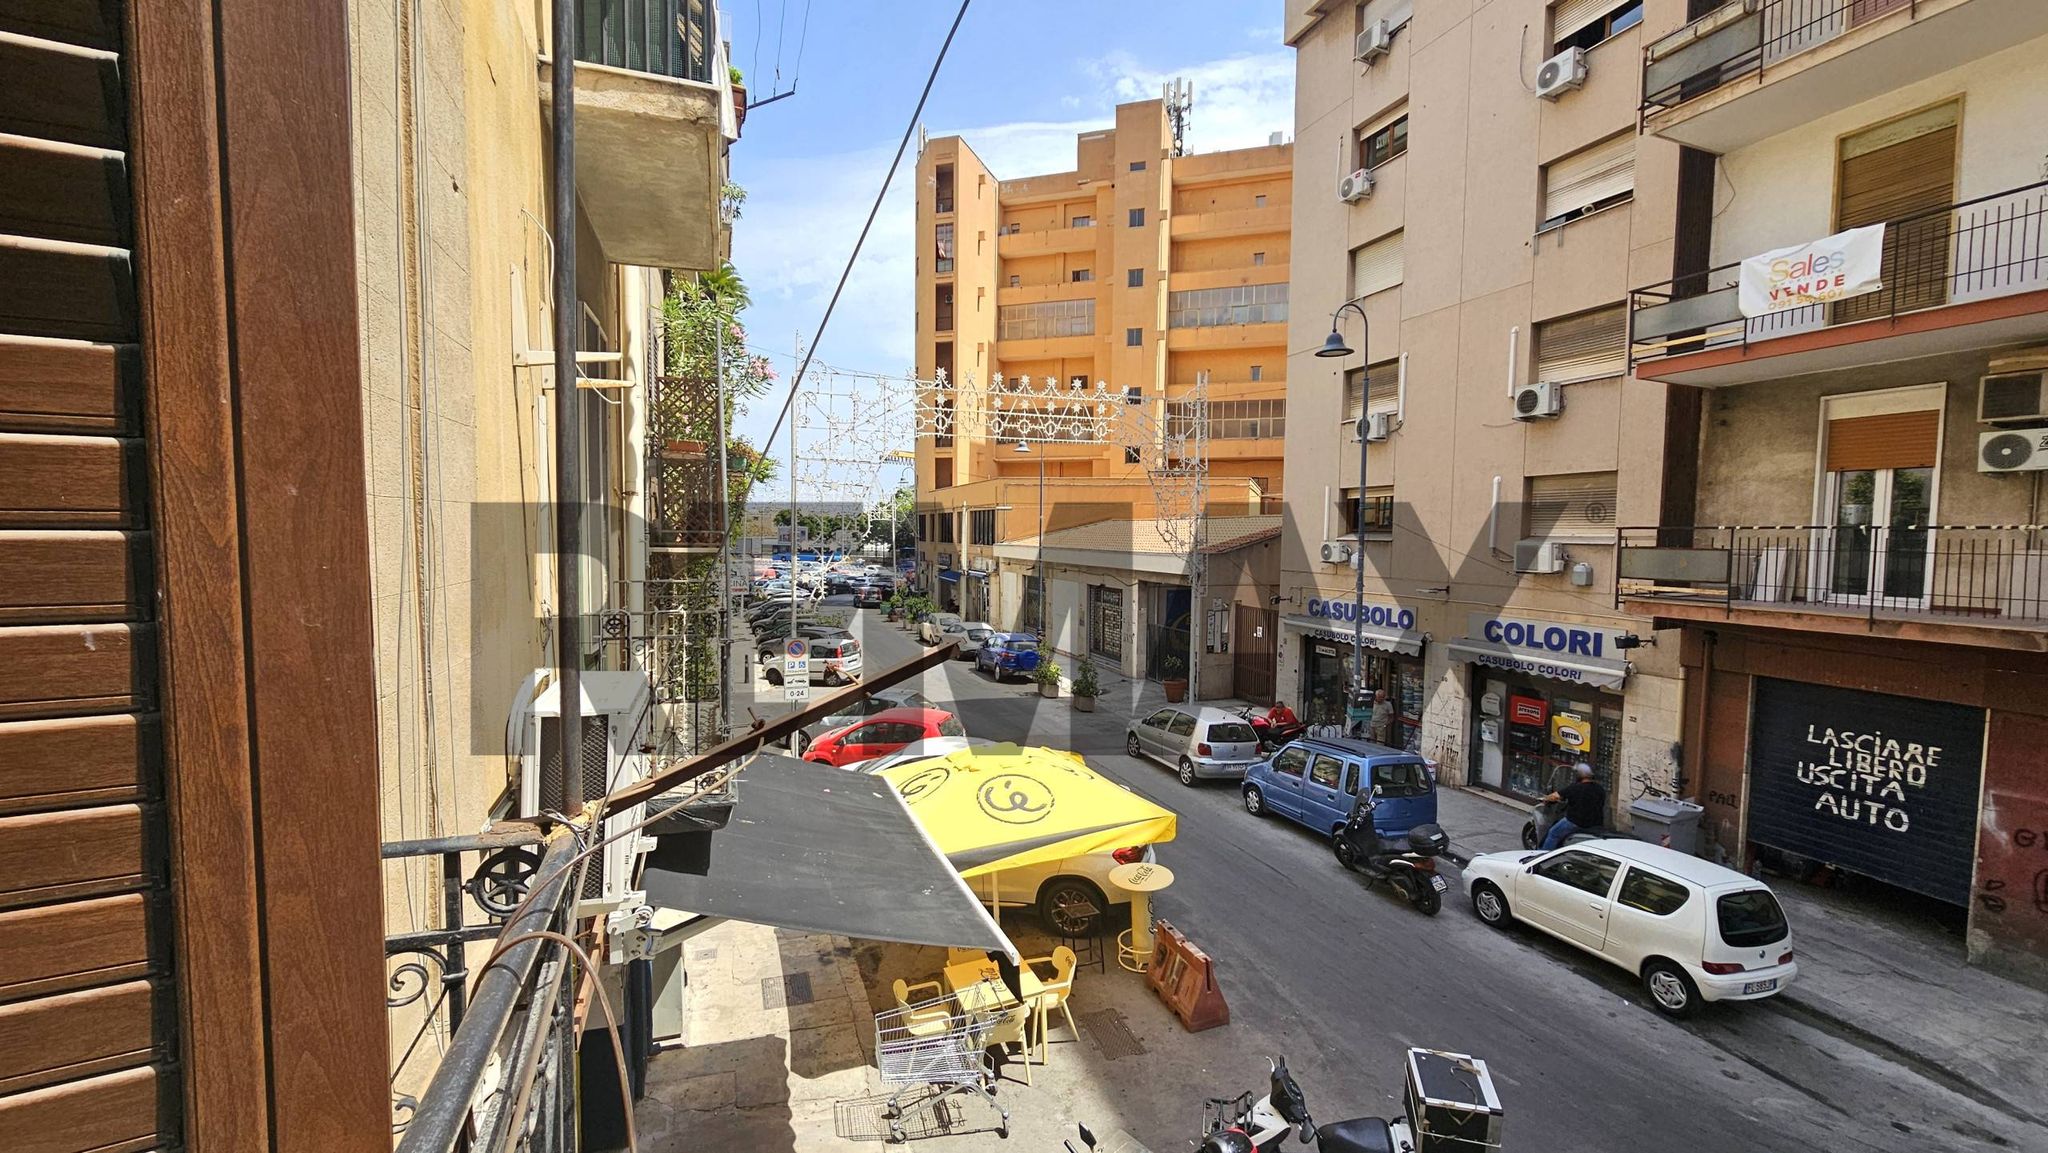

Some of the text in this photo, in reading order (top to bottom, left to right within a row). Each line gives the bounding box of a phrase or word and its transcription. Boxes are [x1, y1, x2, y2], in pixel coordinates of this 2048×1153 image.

[1770, 251, 1845, 282] Sales
[1769, 273, 1845, 301] VENDE
[1308, 599, 1414, 629] CASUBOLO
[1314, 628, 1377, 646] CASUBOLO CLORI
[1484, 620, 1604, 658] COLORI
[1478, 654, 1583, 681] CASUBOLO COLORI
[1807, 723, 1942, 768] LASCIARE
[1796, 760, 1906, 802] USCITA
[1829, 746, 1928, 788] LIBERO
[1814, 791, 1910, 833] AUTO
